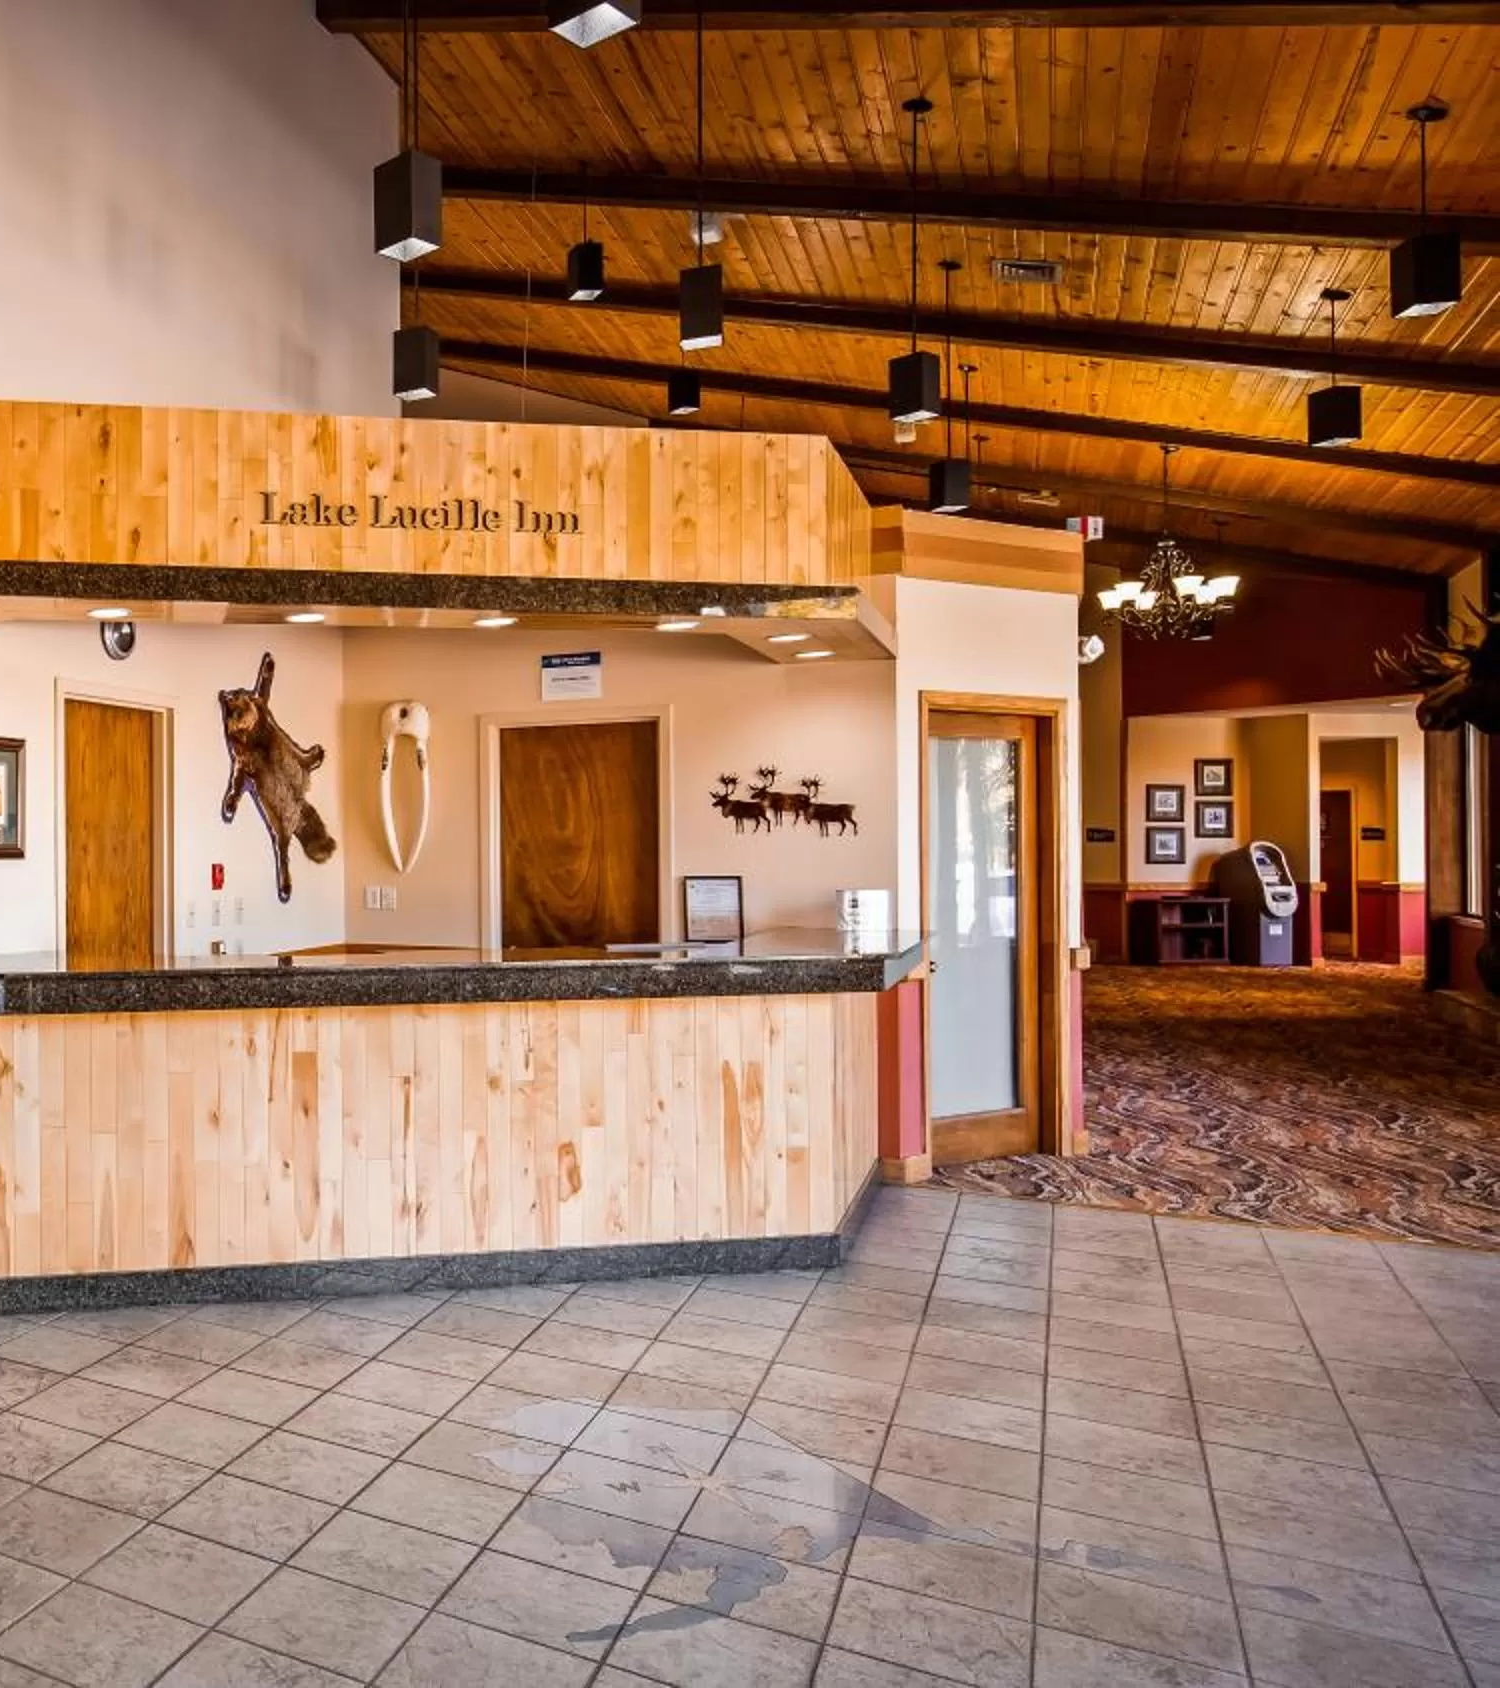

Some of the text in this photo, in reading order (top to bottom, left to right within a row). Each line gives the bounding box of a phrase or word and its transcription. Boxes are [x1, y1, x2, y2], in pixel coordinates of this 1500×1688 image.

[260, 491, 585, 535] Lake Lucille Inn
